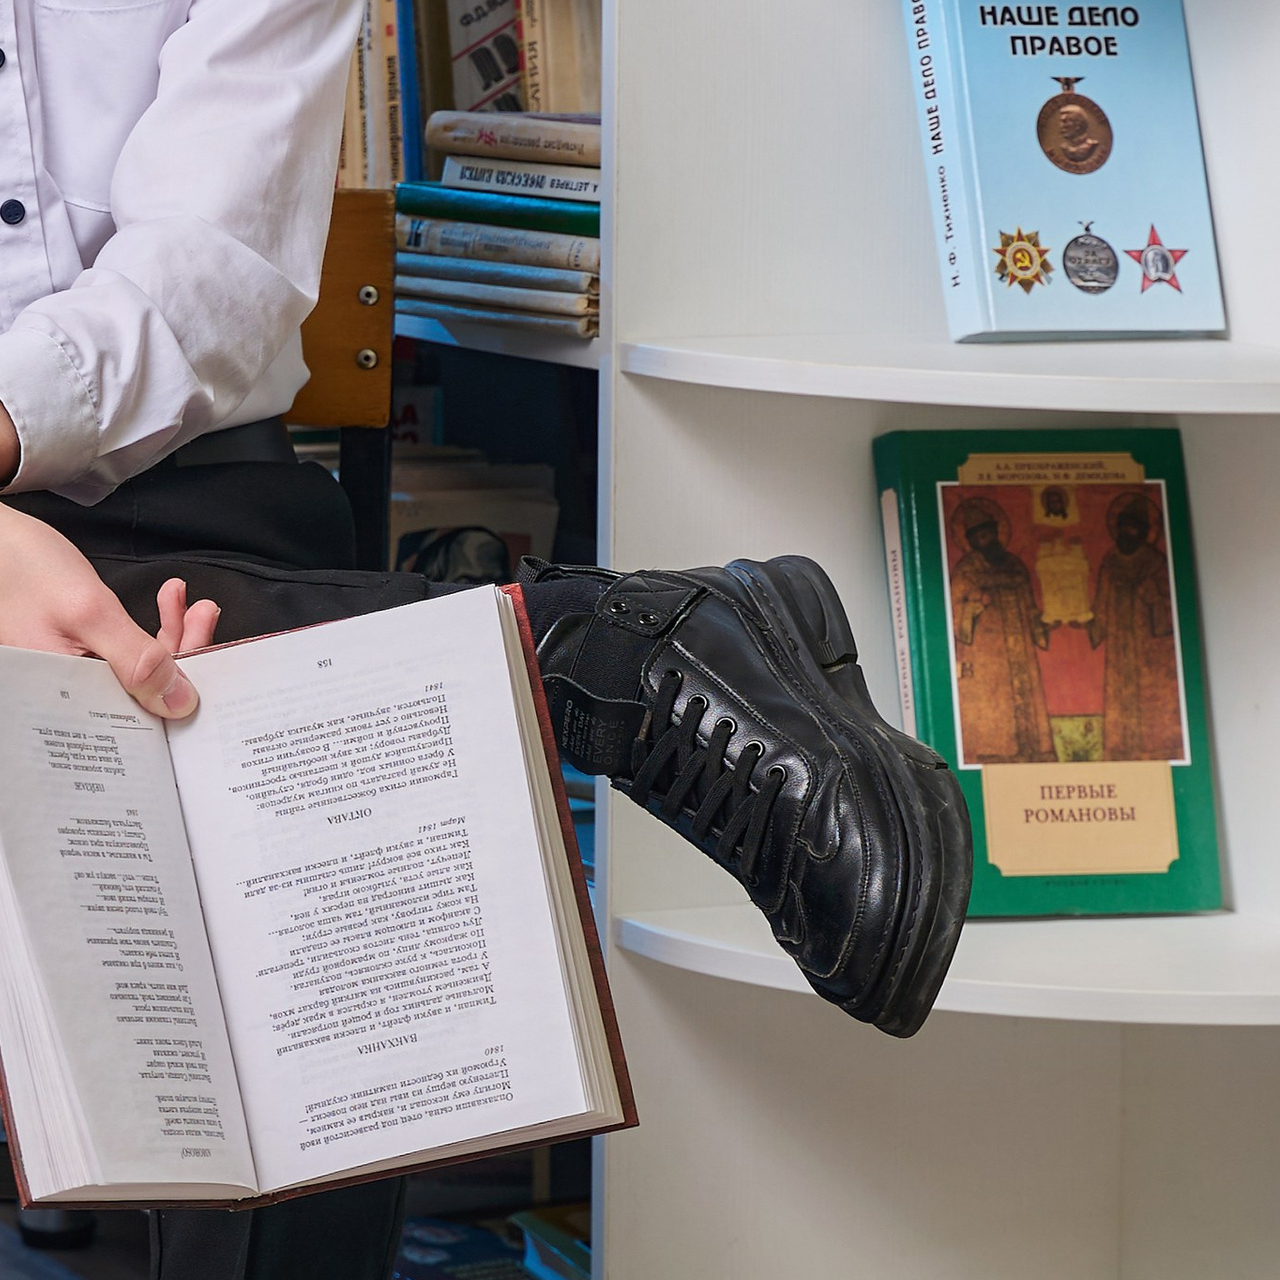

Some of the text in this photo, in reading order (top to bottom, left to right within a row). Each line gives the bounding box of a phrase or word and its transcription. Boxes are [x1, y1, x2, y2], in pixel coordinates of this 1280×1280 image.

[979, 5, 1140, 28] НАШЕ ДЕЛО
[1010, 35, 1119, 57] ПРАВОЕ
[919, 55, 937, 100] ДЕЛО
[926, 105, 945, 155] НАШЕ
[936, 165, 955, 244] Тихненко
[946, 247, 958, 267] Ф.
[951, 270, 962, 288] Н.
[317, 659, 332, 669] 158
[425, 682, 443, 692] 1841
[241, 694, 446, 746] Польются, звучные, как музыка дубравы.
[408, 724, 451, 741] Дубравы
[593, 719, 608, 764] EVERY
[370, 737, 406, 750] говору;
[384, 737, 453, 758] Прислушайся
[604, 720, 619, 765] ONCE
[330, 749, 352, 759] звук
[350, 752, 382, 767] душой
[261, 755, 328, 777] необычайный
[289, 763, 339, 780] шептанью
[228, 775, 287, 793] тростников,
[275, 769, 458, 817] Гармонии стиха божественные тайны
[1039, 783, 1118, 802] ПЕРВЫЕ
[327, 807, 372, 825] ОКТАВА
[1024, 805, 1136, 824] РОМАНОВЫ
[418, 816, 466, 834] Март 1841
[426, 850, 471, 865] Лепечут,
[387, 861, 424, 875] полные
[318, 861, 473, 902] Как алые уста, улыбкою играя,
[339, 870, 386, 886] томленья
[303, 883, 328, 897] огня!
[429, 939, 487, 957] Покоилась,
[395, 953, 418, 966] руке
[409, 960, 449, 974] темного
[450, 952, 478, 964] грота
[344, 961, 393, 977] склонясь,
[361, 969, 407, 985] вакханка
[290, 973, 342, 991] полунагая.
[319, 980, 359, 996] молодая
[445, 984, 494, 1001] Молчанье
[383, 1006, 400, 1015] гор
[402, 995, 443, 1011] дальних
[341, 1011, 372, 1027] рощей
[287, 1021, 339, 1039] потрясали.
[357, 1033, 418, 1055] ВАКХАНКА
[484, 1045, 504, 1056] 1840
[461, 1057, 507, 1075] Угрюмой
[400, 1072, 444, 1088] бедности
[350, 1083, 398, 1100] памятник
[305, 1095, 348, 1114] скудный!
[299, 1092, 514, 1151] Оплакавши сына, отец под развесистой ивой
